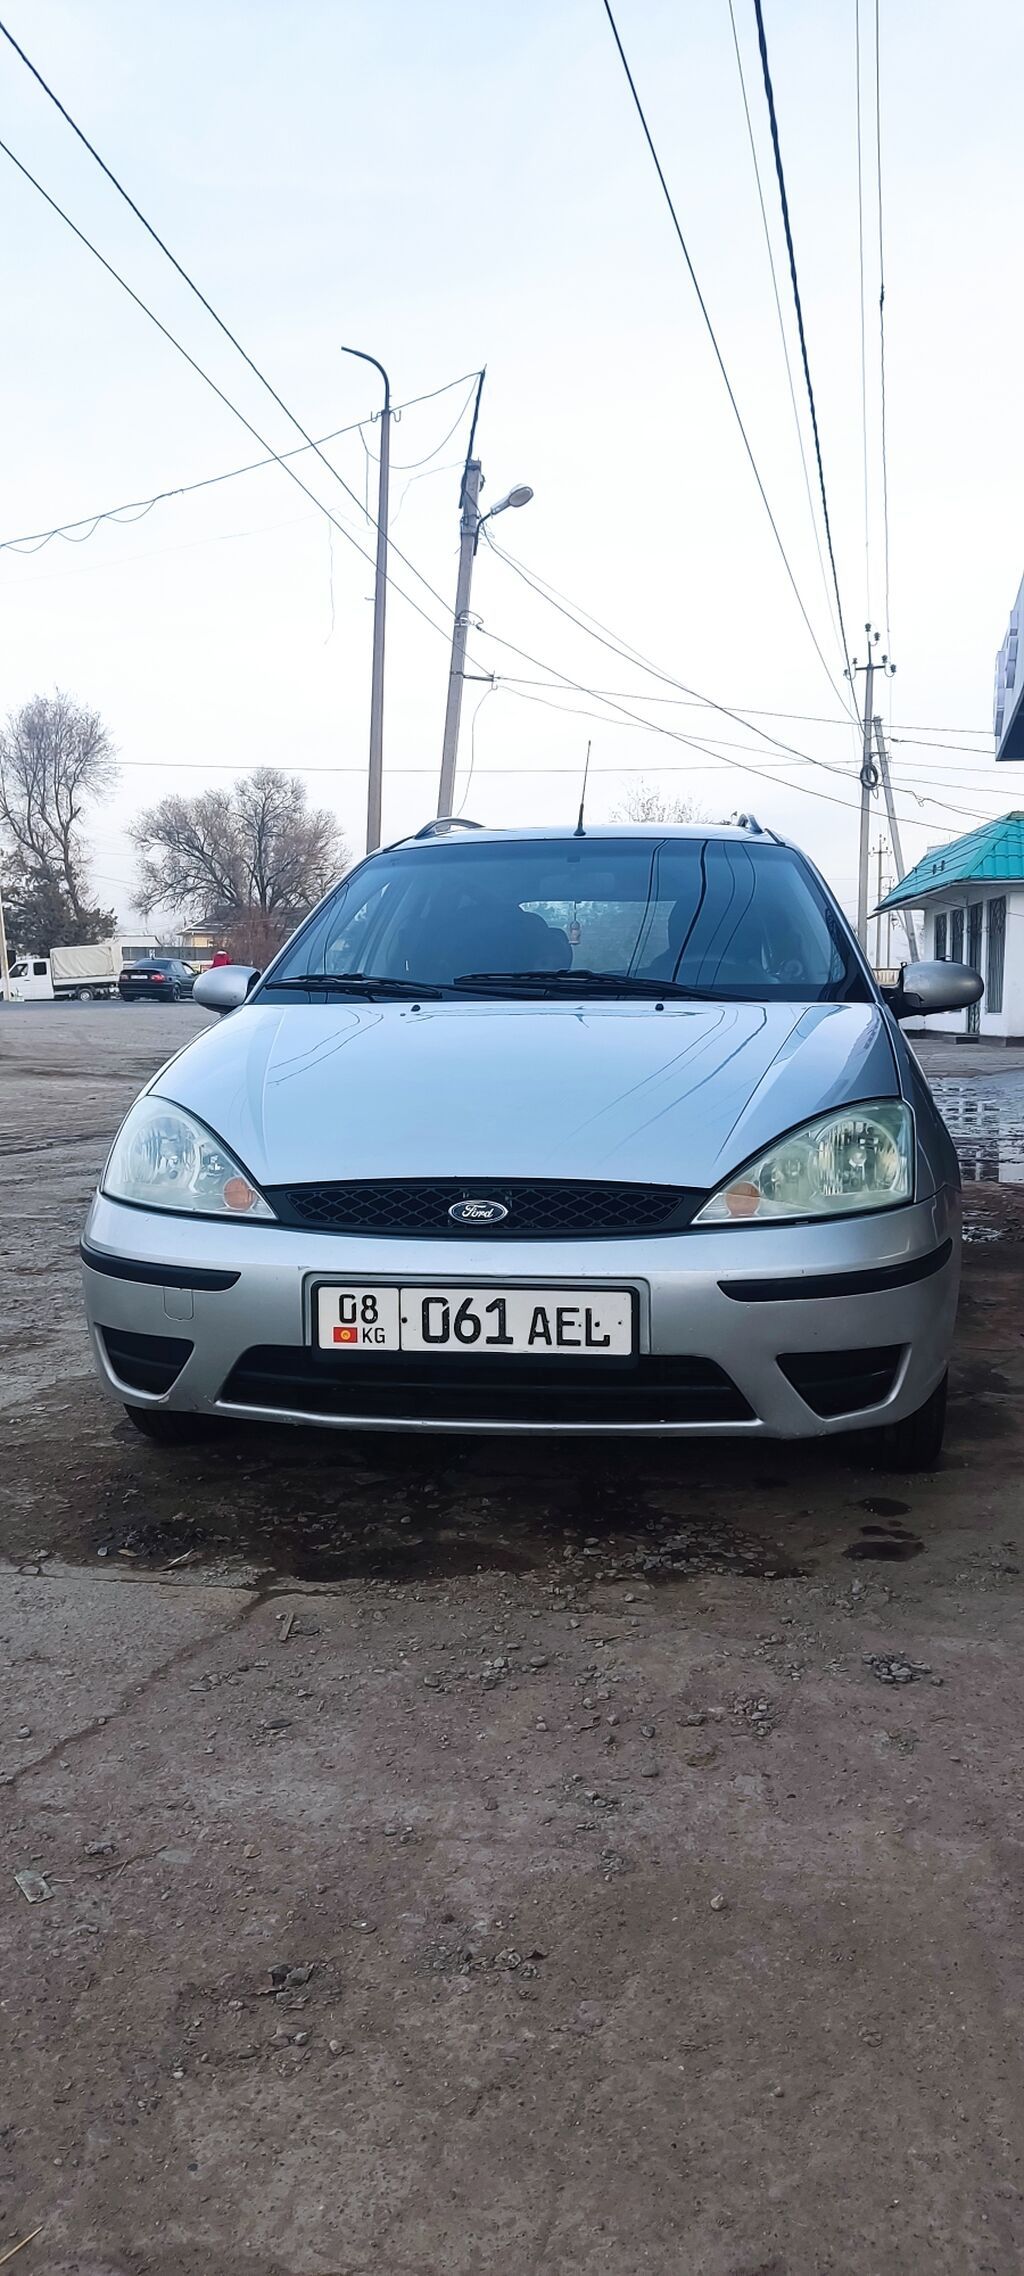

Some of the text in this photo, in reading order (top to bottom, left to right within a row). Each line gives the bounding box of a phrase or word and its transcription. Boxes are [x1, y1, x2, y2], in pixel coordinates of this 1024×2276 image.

[461, 1204, 495, 1218] Ford
[338, 1293, 379, 1324] 08
[421, 1296, 611, 1347] 061 AEL
[362, 1327, 386, 1344] KG
